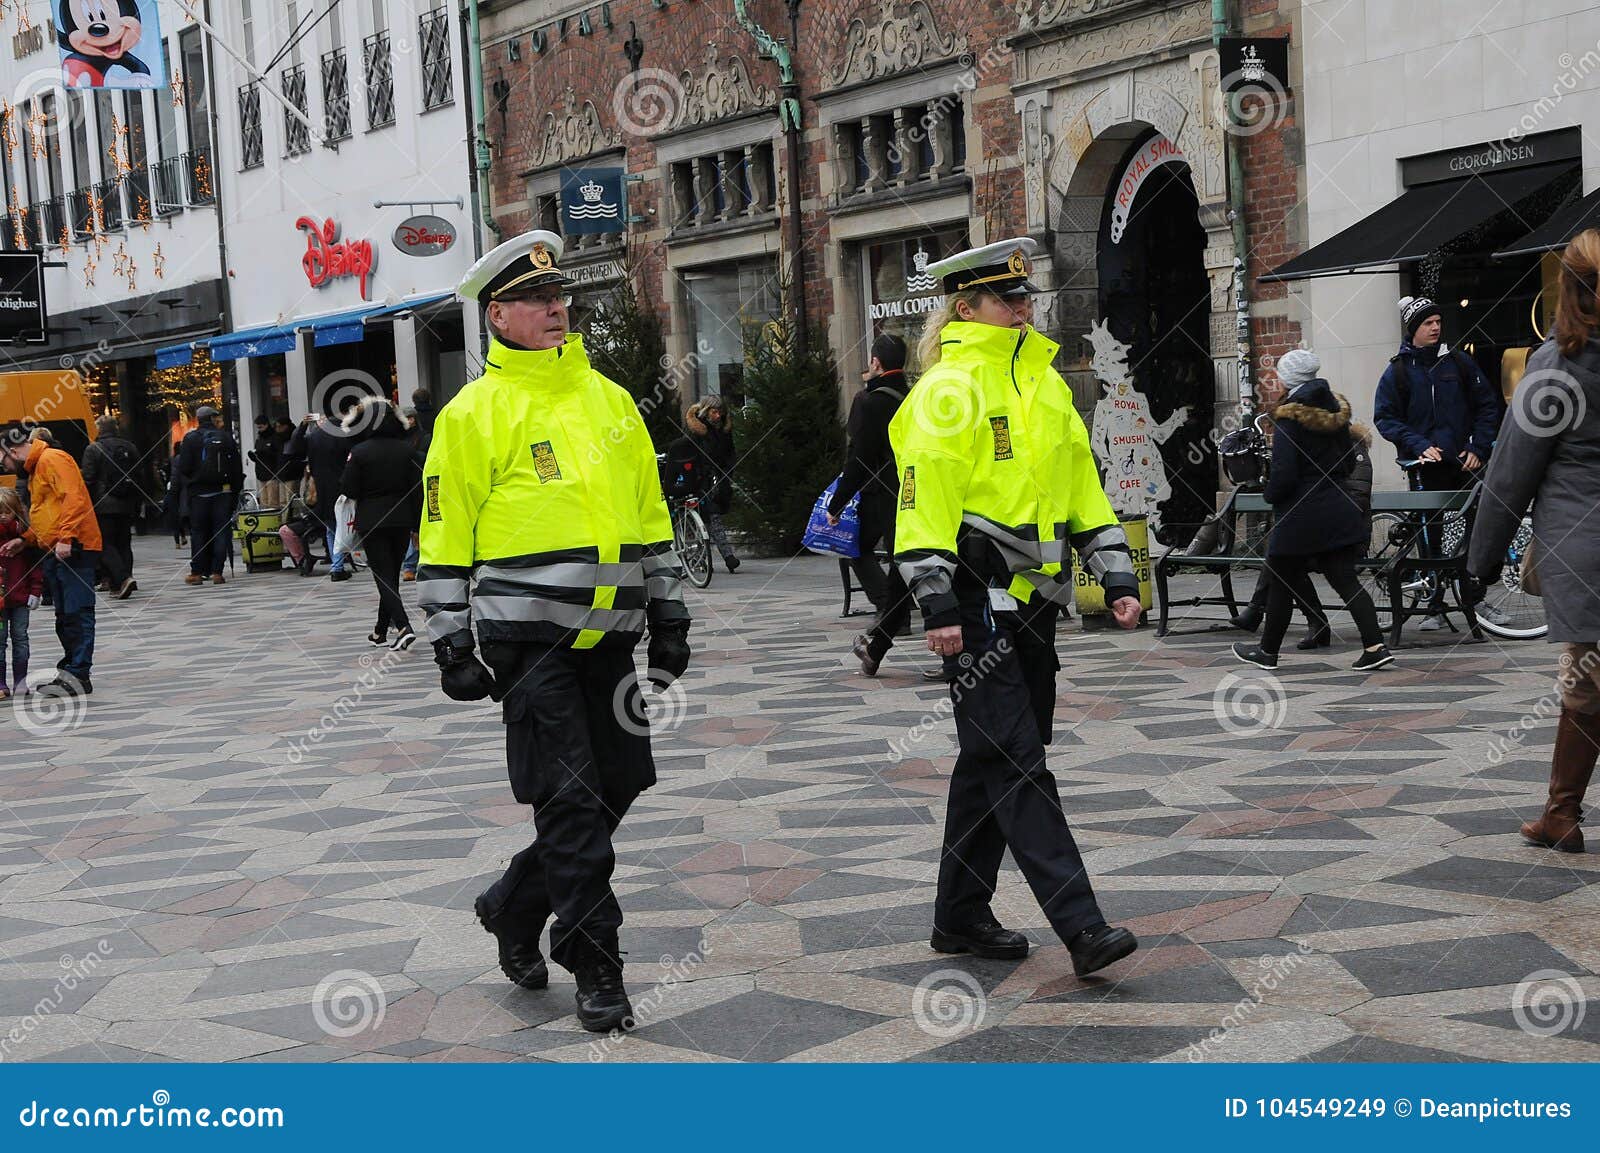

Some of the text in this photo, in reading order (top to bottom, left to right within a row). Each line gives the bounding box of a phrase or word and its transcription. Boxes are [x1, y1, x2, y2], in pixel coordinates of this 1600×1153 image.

[1450, 144, 1534, 171] GEORG JENSEN
[1119, 154, 1150, 208] ROYAL
[0, 297, 38, 310] olighus
[868, 301, 904, 320] ROYAL
[1114, 400, 1140, 410] ROYAL
[1113, 435, 1145, 446] SMUSHI
[1119, 479, 1140, 489] CAFE
[1134, 567, 1151, 583] KB
